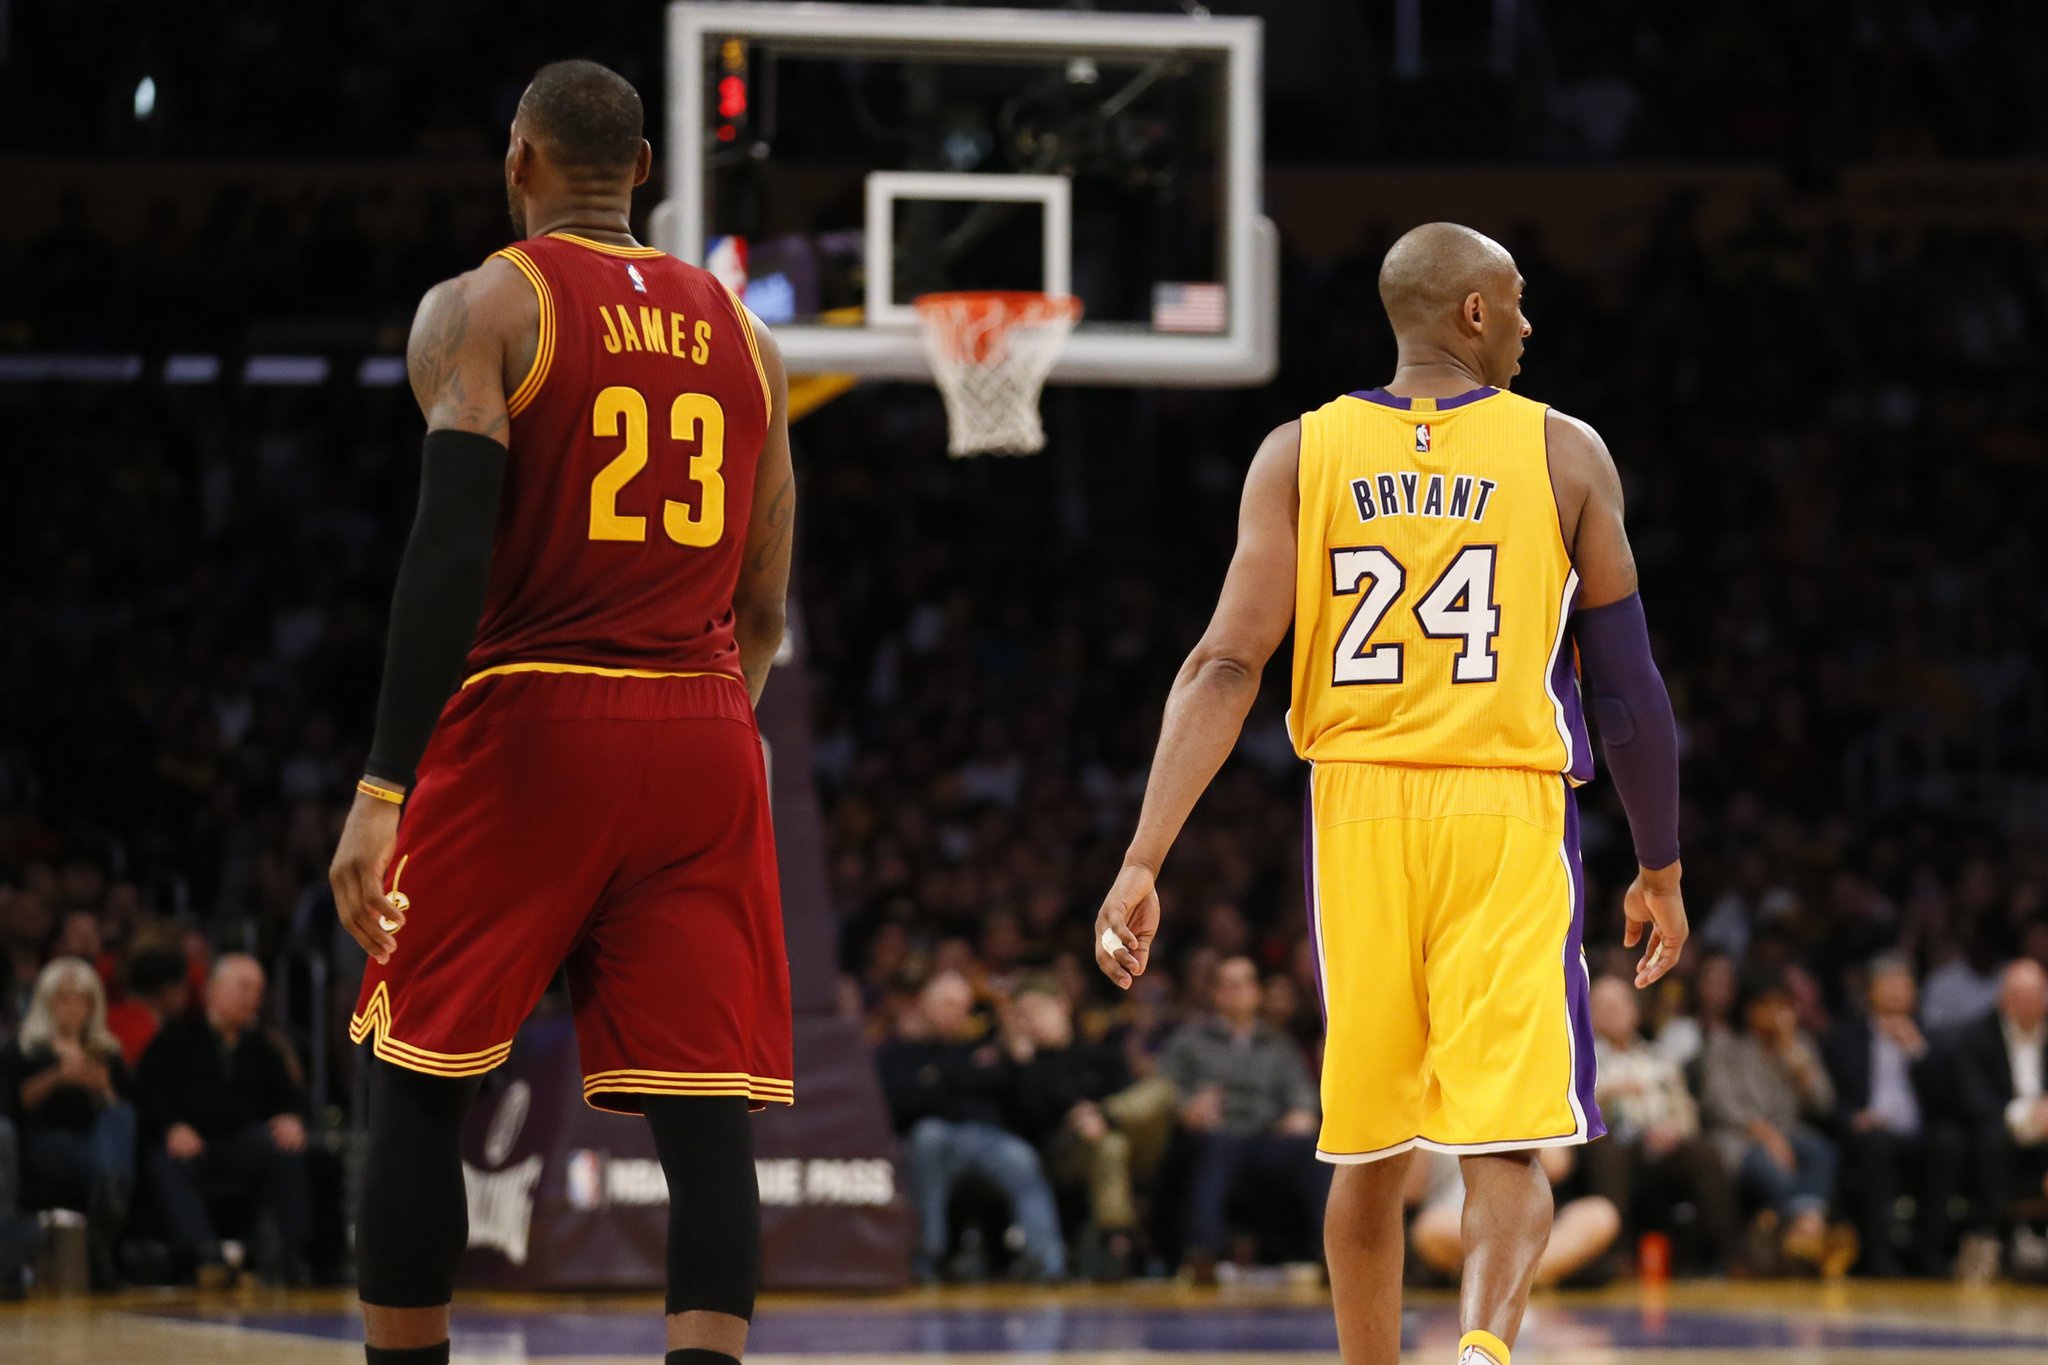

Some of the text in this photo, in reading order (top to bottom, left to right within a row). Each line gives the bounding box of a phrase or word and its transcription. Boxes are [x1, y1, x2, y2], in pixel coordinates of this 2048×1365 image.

[599, 304, 712, 366] JAMES
[588, 386, 725, 548] 23
[1350, 471, 1498, 524] BRYANT
[1329, 543, 1501, 687] 24
[806, 1157, 895, 1206] PASS
